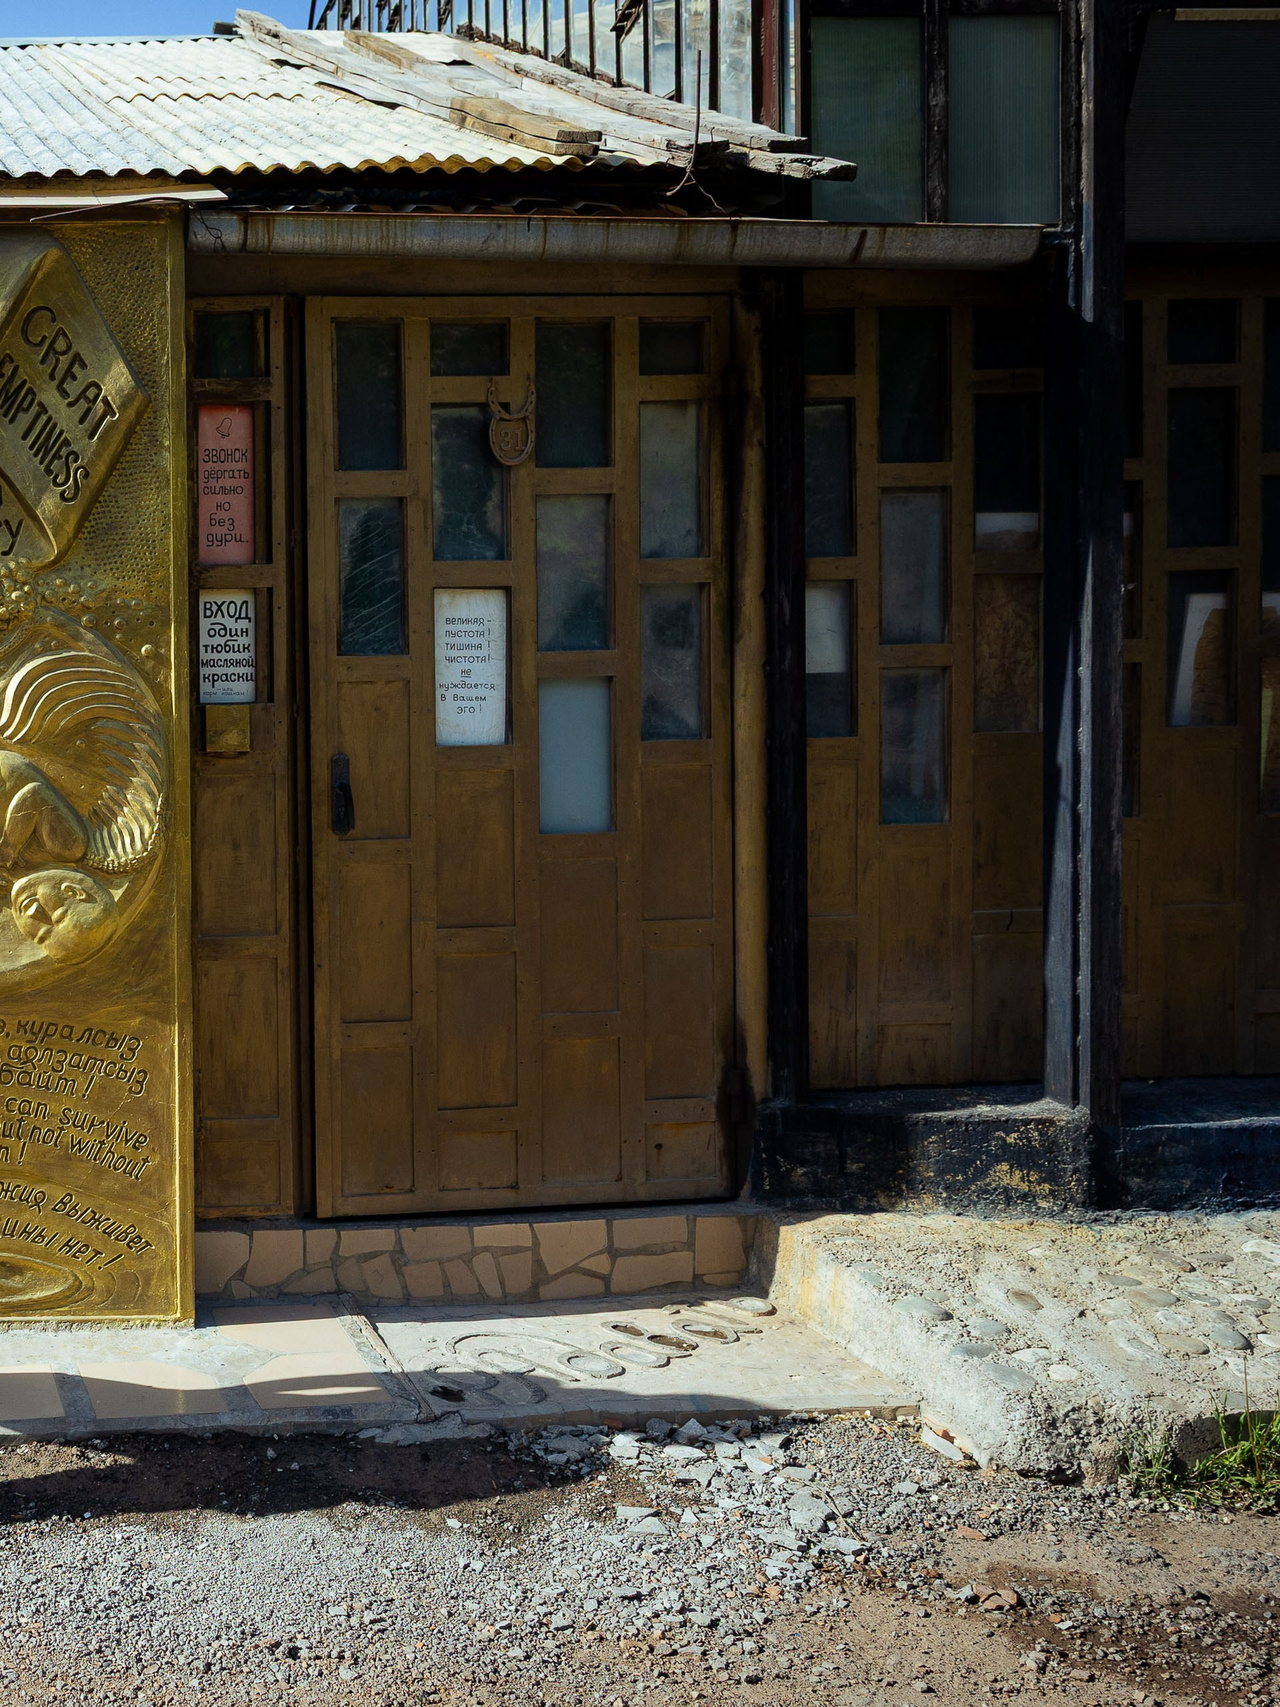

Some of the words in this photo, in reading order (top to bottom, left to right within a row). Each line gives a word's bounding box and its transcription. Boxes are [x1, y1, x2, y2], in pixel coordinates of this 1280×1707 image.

[21, 305, 119, 442] GREAT
[501, 428, 525, 451] 31
[202, 448, 248, 463] ЗВОНОК
[203, 467, 250, 484] дёргать
[203, 485, 244, 495] сильно
[216, 501, 231, 511] но
[209, 512, 235, 531] без
[206, 533, 249, 547] дури.
[203, 600, 251, 623] ВХОД
[207, 622, 249, 638] один
[203, 639, 251, 653] тюбик
[201, 656, 255, 668] масляной
[202, 672, 255, 688] краски
[439, 680, 495, 691] нуждается
[16, 1019, 143, 1062] куралсыз
[4, 1096, 50, 1121] can
[59, 1107, 150, 1152] survive
[29, 1124, 68, 1148] not
[70, 1133, 151, 1182] without
